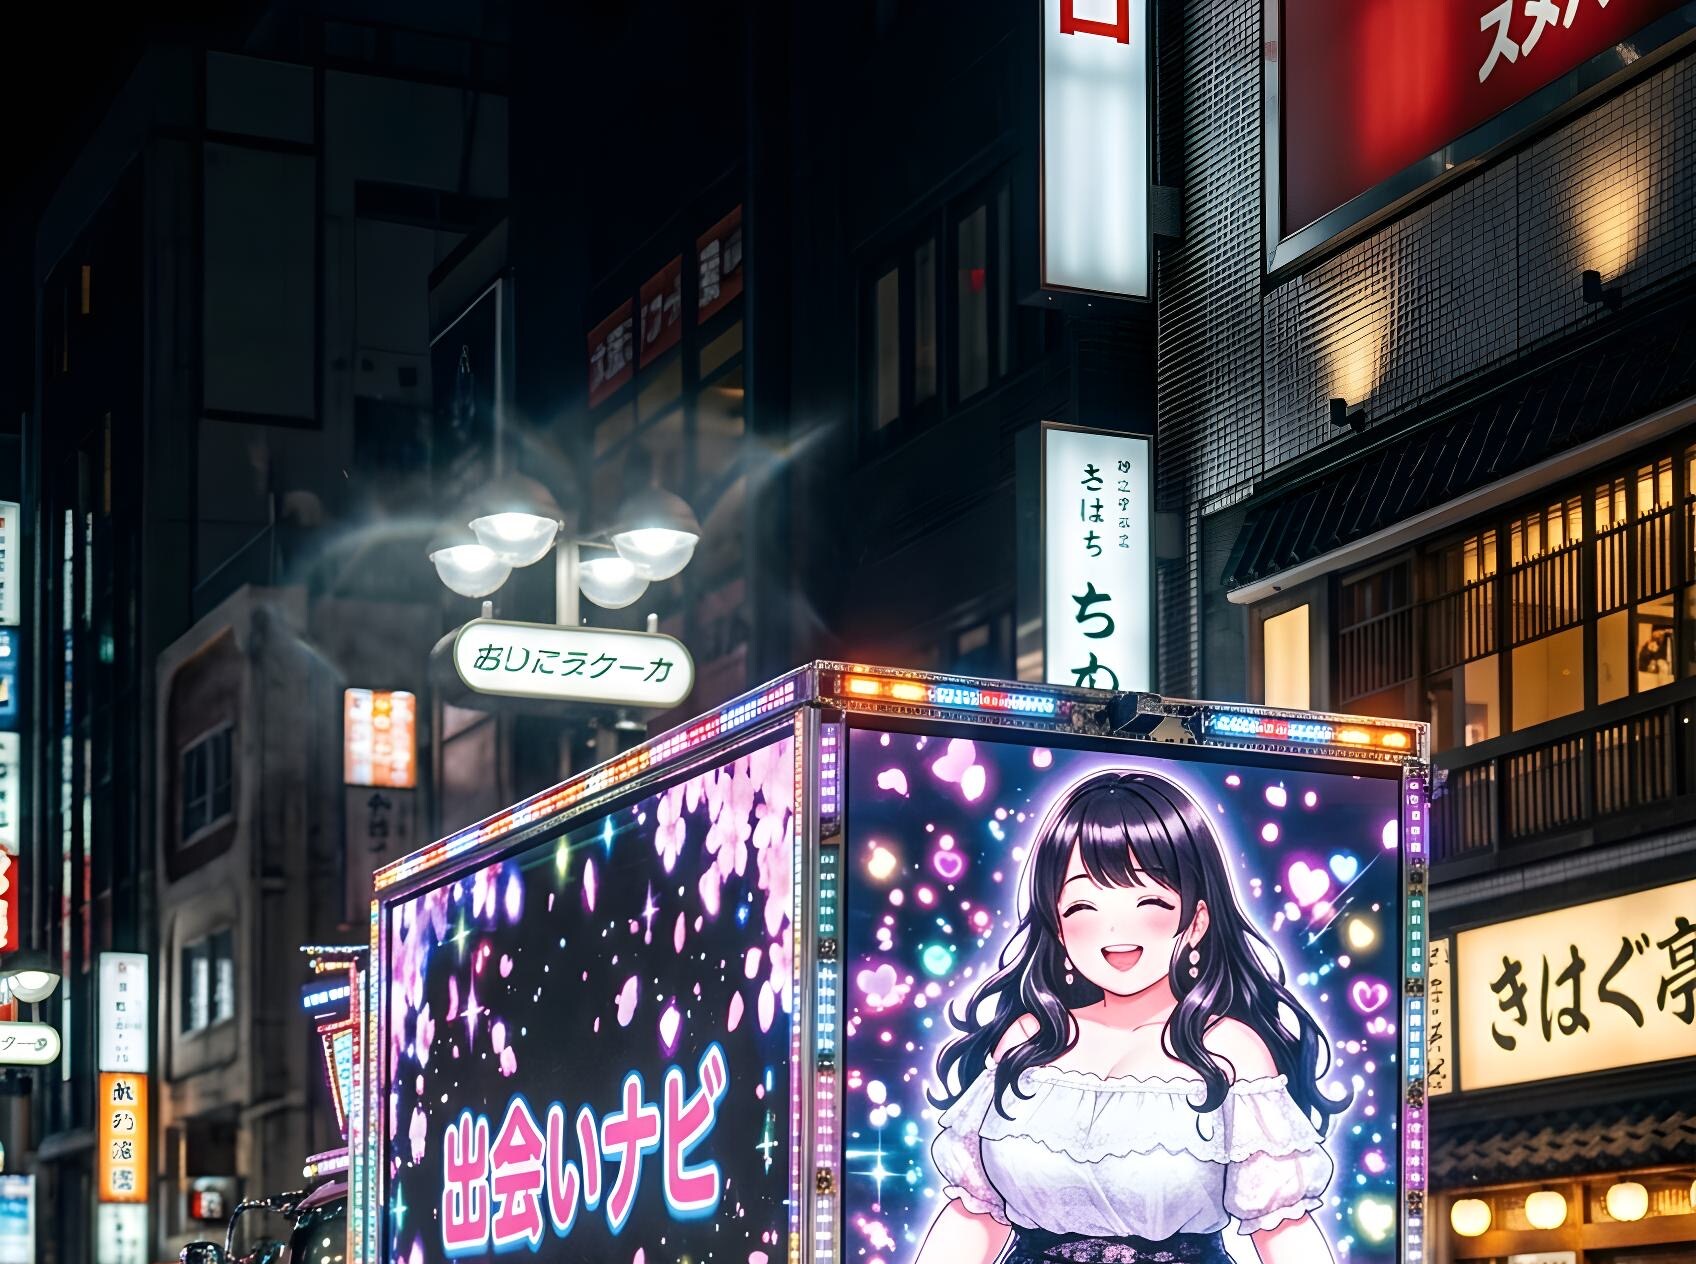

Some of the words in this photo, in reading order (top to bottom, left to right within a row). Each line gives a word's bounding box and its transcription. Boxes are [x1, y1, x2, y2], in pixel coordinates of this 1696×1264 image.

[442, 1044, 728, 1251] 出会いナビ
